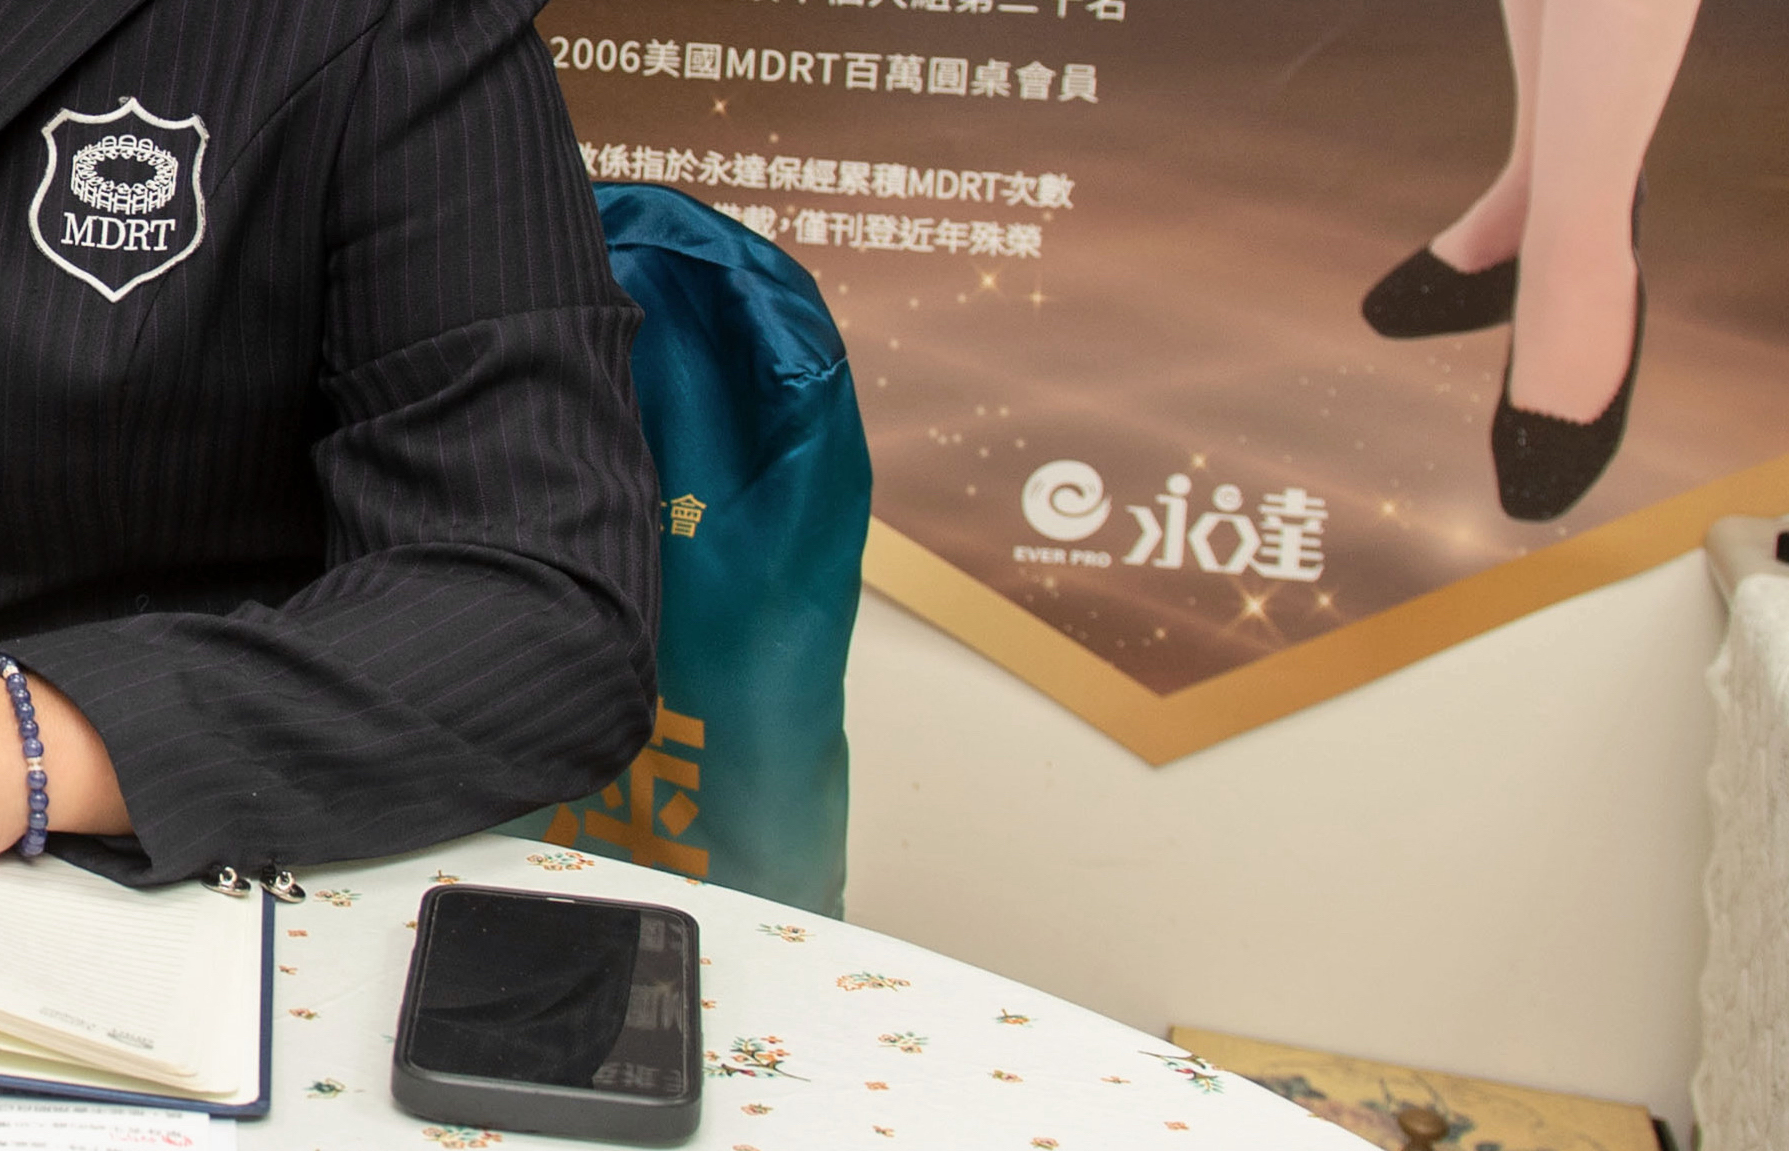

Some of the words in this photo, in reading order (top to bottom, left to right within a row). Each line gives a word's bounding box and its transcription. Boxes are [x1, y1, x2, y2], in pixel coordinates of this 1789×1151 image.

[60, 210, 176, 252] MDRT
[1013, 545, 1067, 566] EVER
[1070, 550, 1113, 569] PRO
